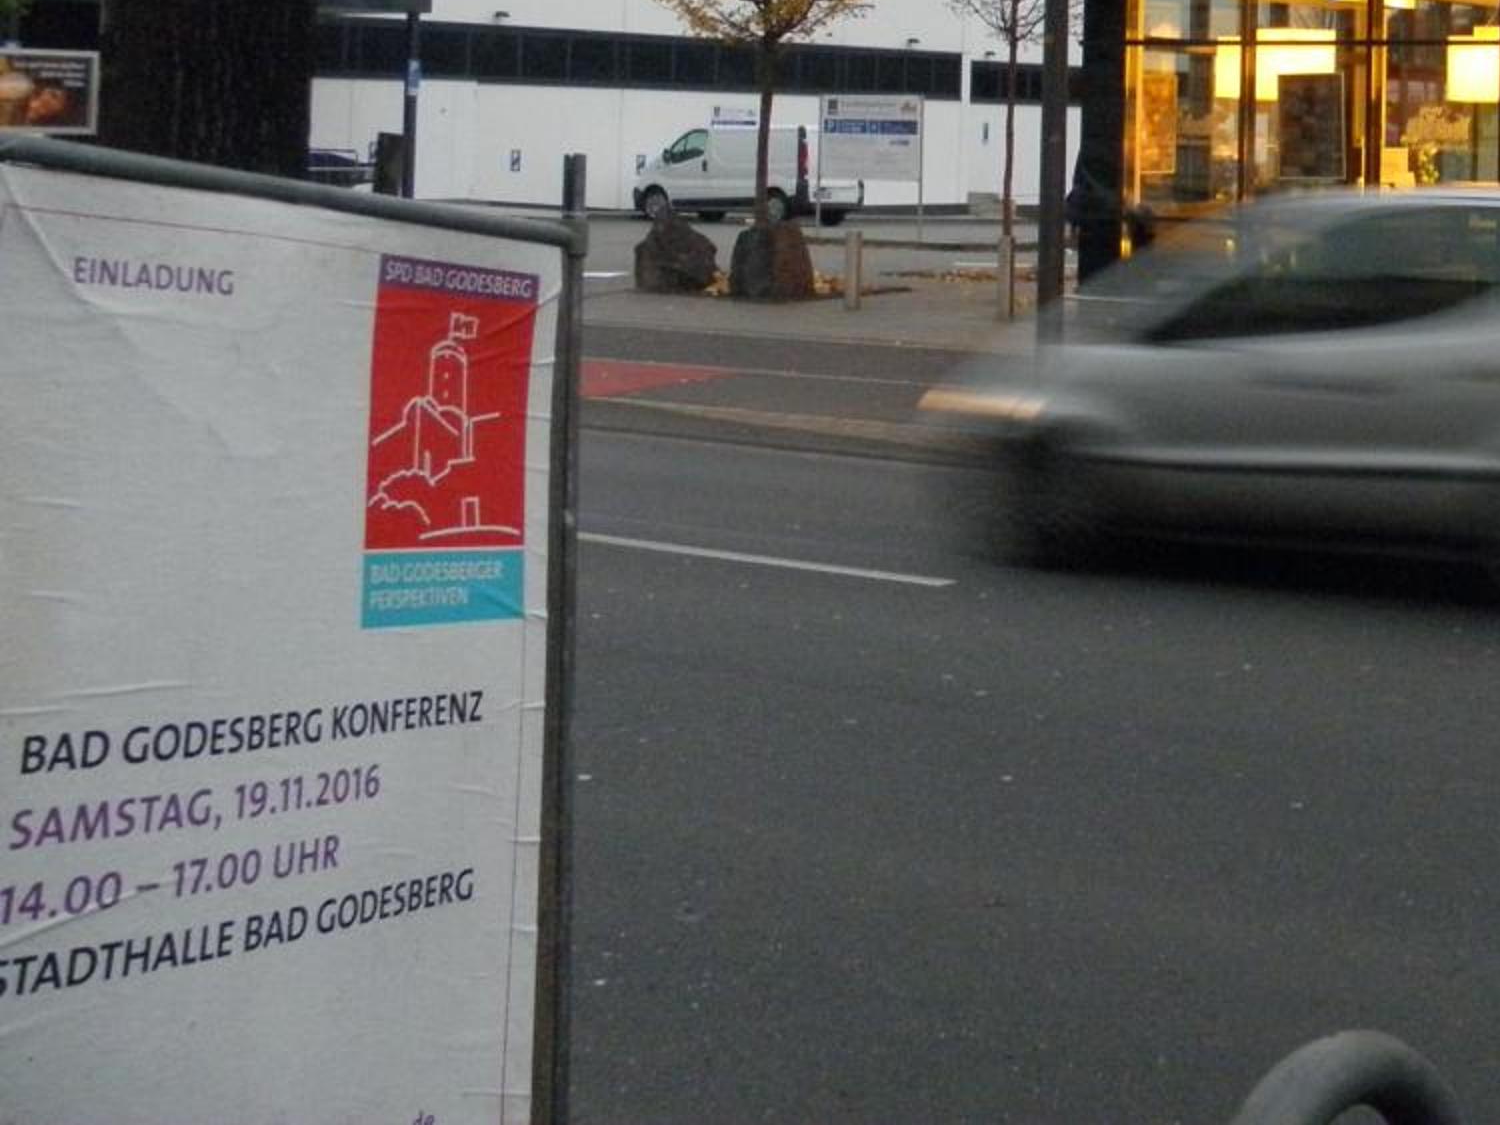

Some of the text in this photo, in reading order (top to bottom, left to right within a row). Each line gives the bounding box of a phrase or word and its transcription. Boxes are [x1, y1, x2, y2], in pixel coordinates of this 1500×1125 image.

[73, 256, 234, 296] EINLADUNG
[385, 259, 533, 298] SPD BAD GODESBERG
[369, 559, 504, 584] BAD GODESBERGER
[369, 586, 469, 610] PERSPEKTIVEN
[21, 690, 483, 774] BAD GODESBERG KONFERENZ
[9, 764, 381, 851] SAMSTAG, 19.11.2016
[0, 871, 122, 925] 14.00
[173, 848, 261, 898] 17.00
[273, 835, 340, 879] UHR
[243, 906, 308, 952] BAD
[316, 868, 475, 935] GODESBERG
